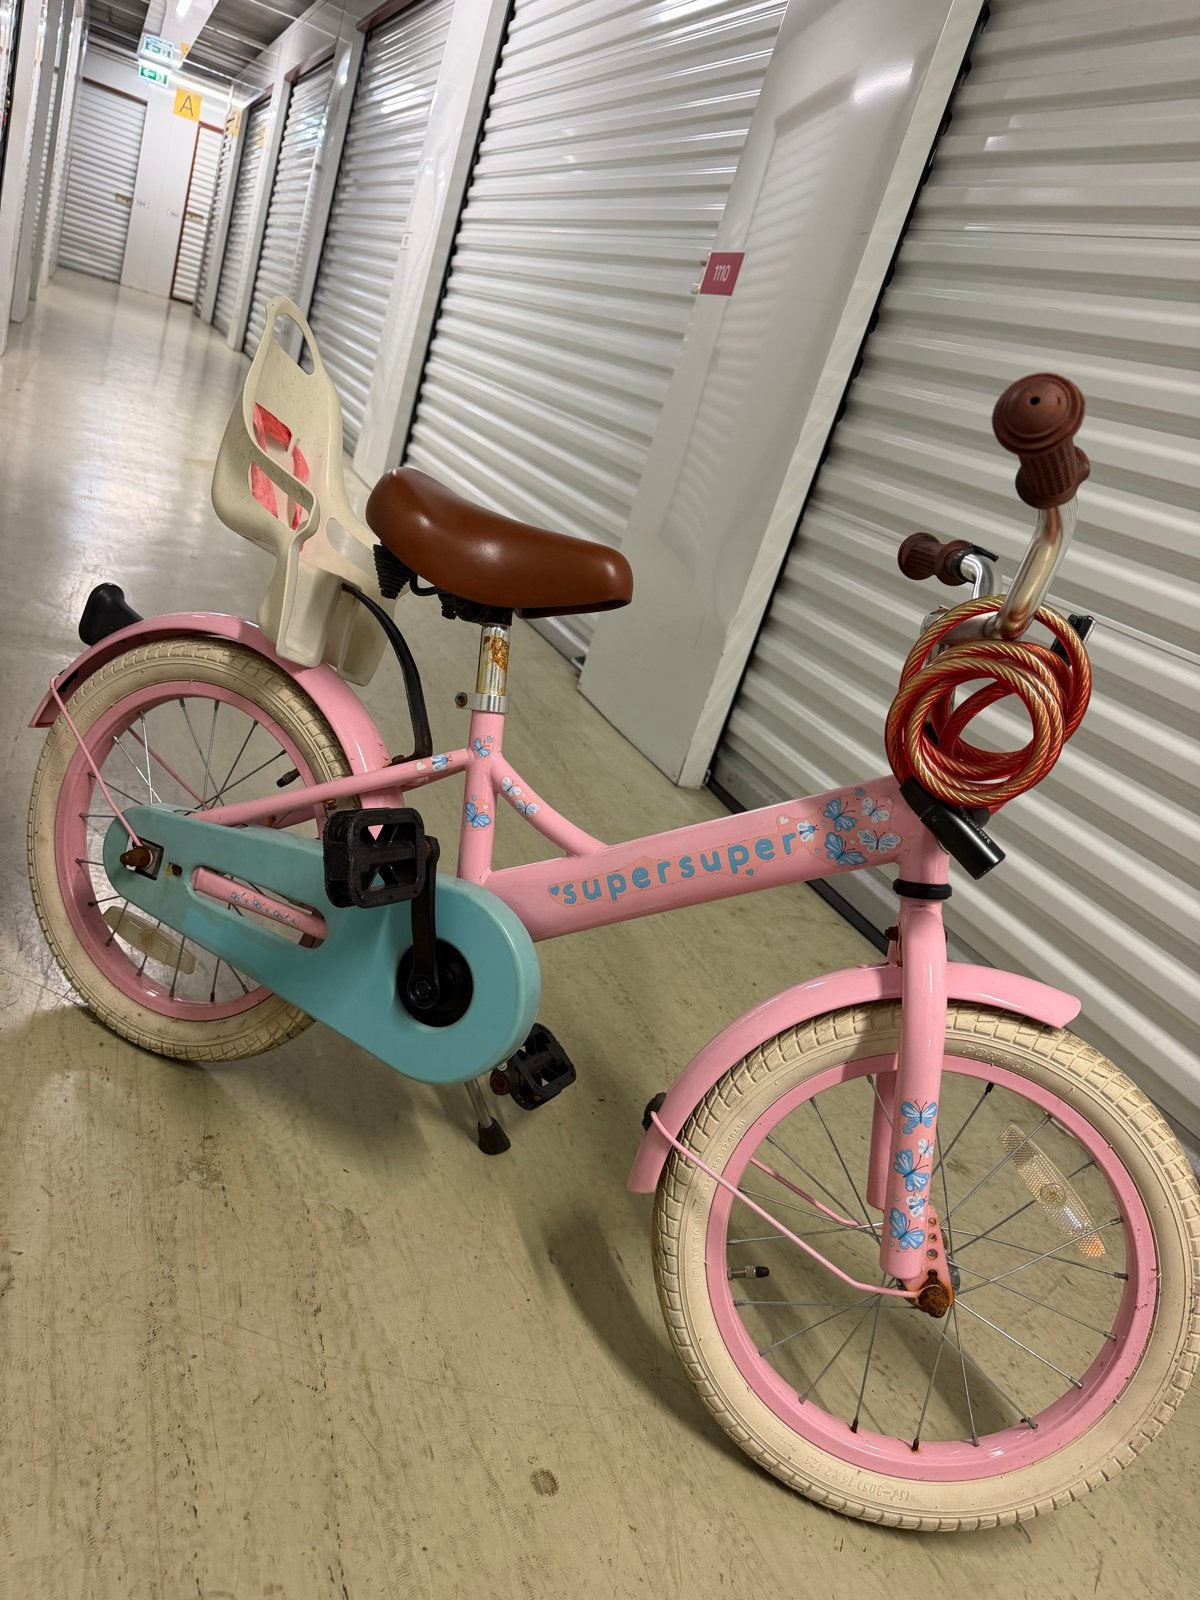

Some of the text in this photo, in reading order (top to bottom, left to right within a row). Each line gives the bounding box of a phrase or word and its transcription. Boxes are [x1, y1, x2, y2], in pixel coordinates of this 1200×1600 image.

[179, 94, 194, 117] A
[713, 264, 731, 282] 1110
[562, 831, 797, 905] supersuper
